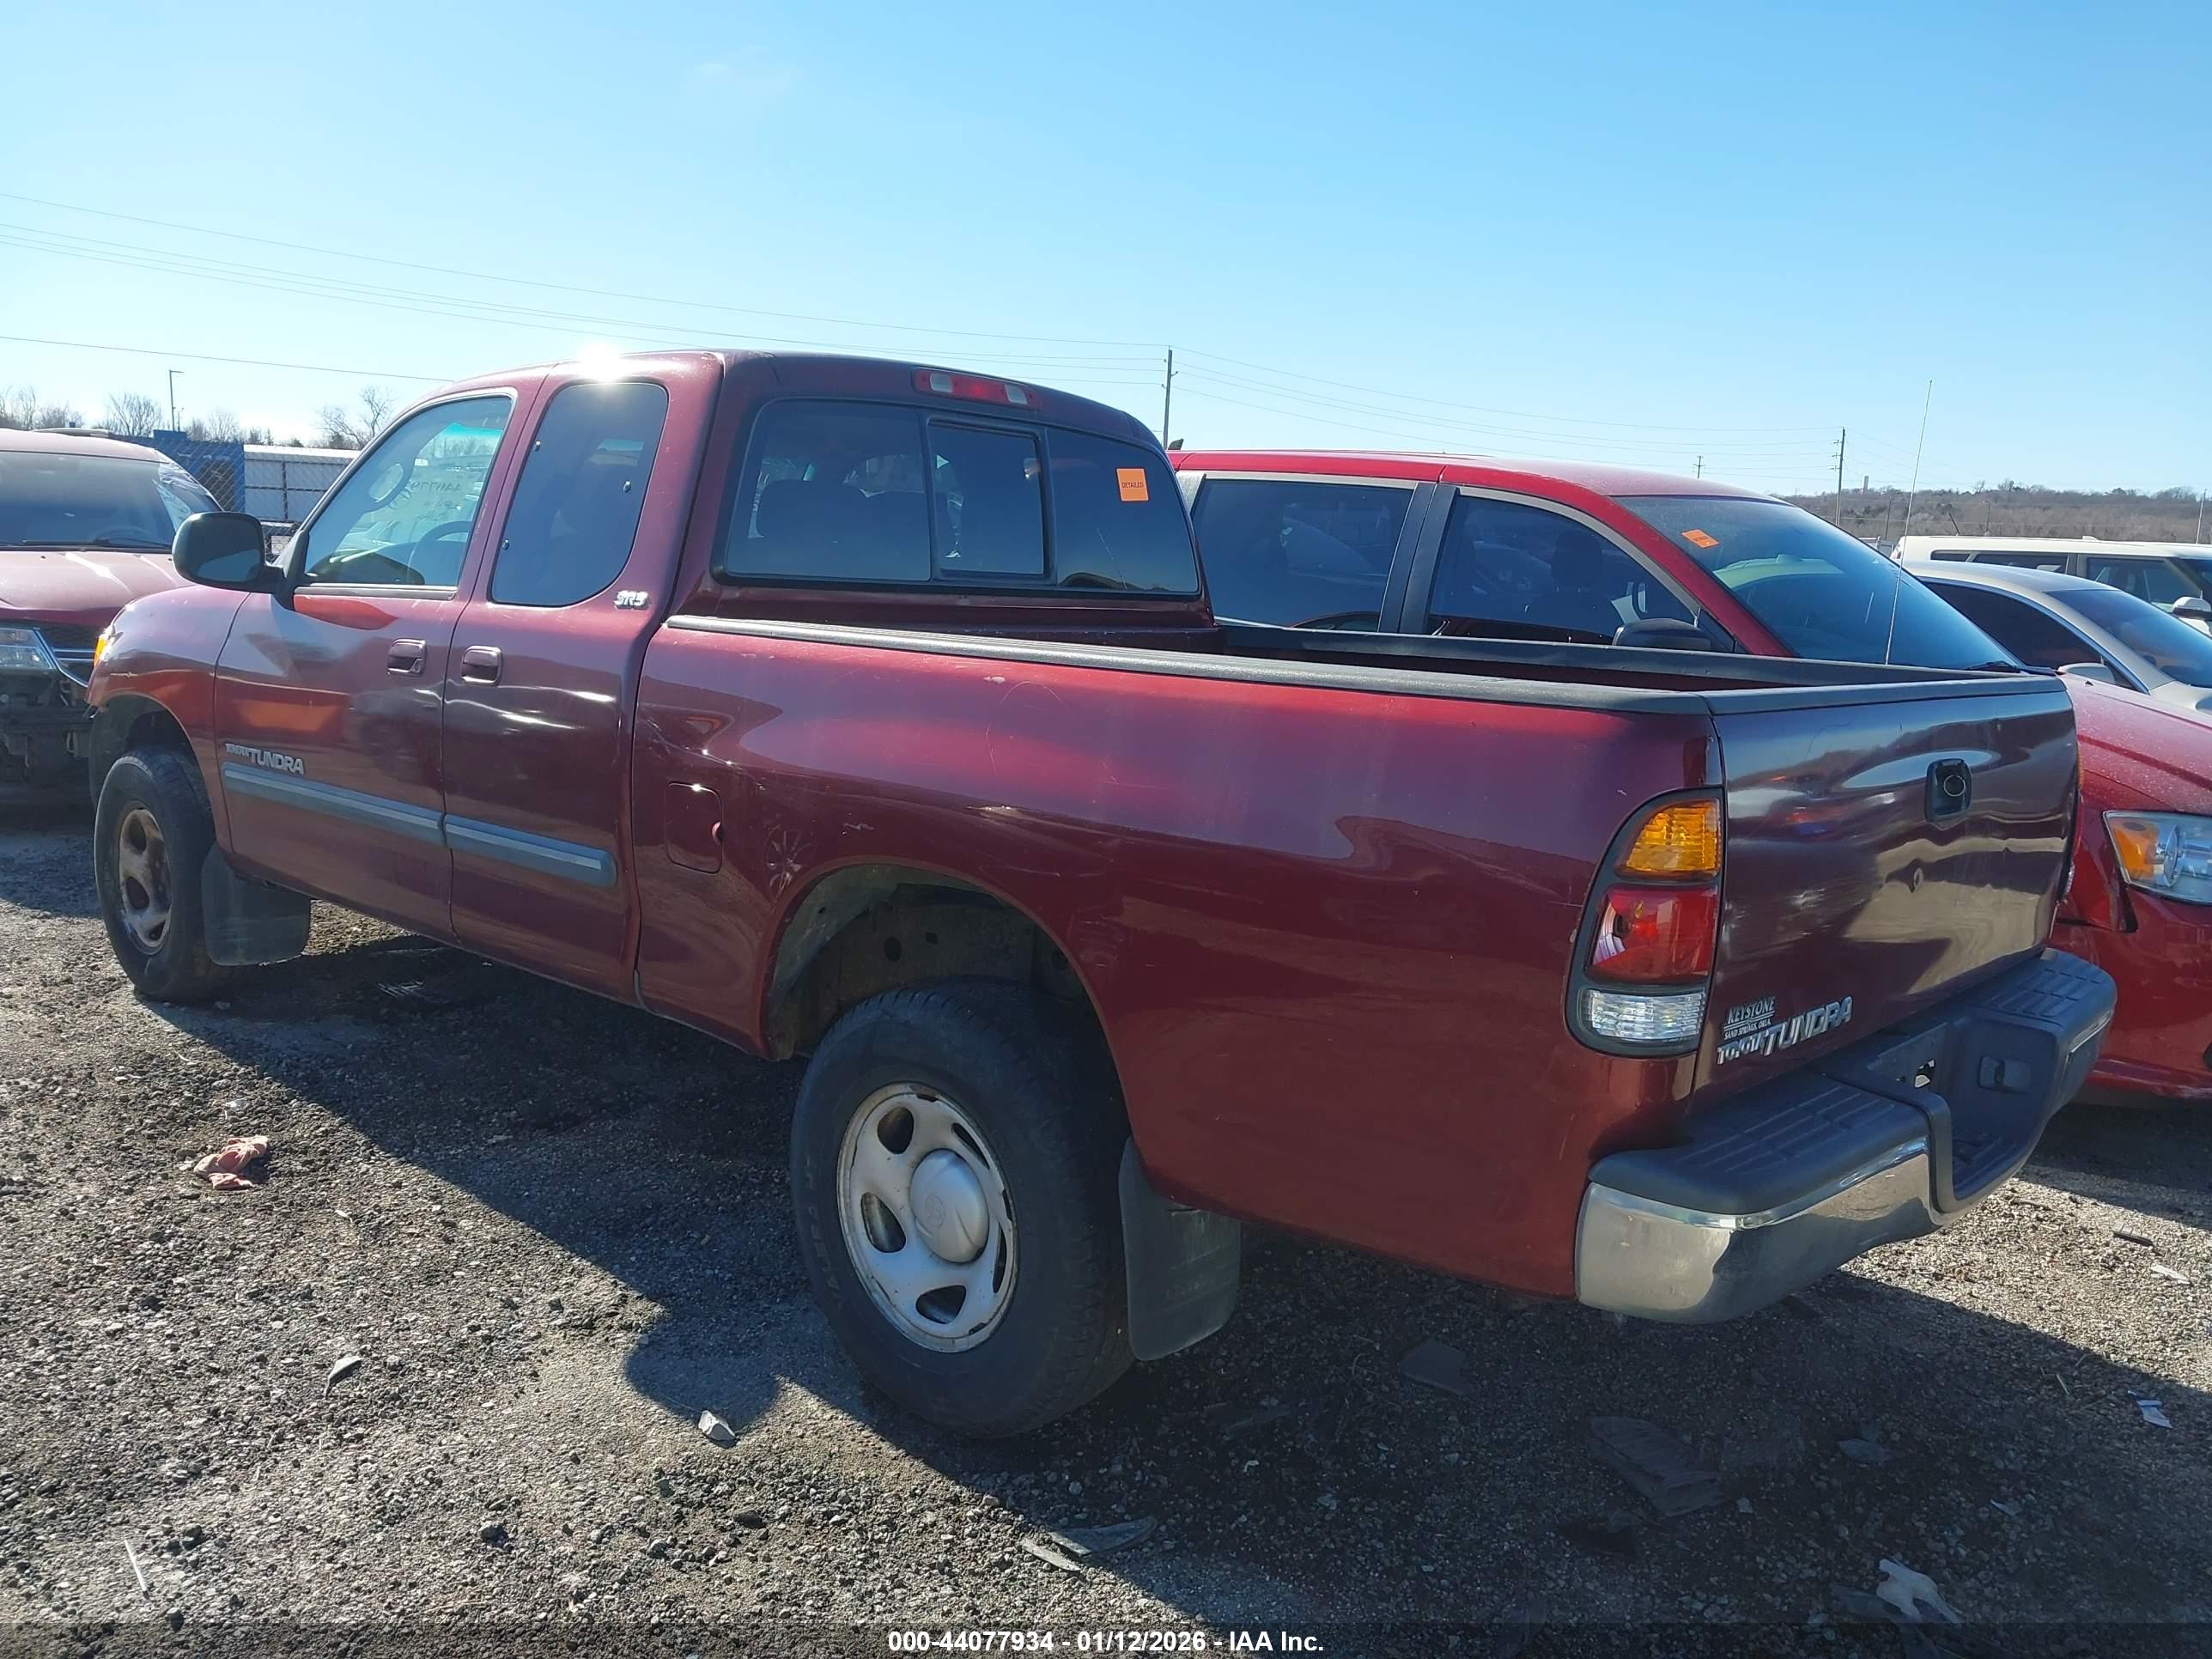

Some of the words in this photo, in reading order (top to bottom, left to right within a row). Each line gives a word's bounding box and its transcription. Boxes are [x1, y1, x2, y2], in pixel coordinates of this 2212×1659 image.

[249, 747, 305, 775] TUNDRA
[1727, 996, 1776, 1024] KEYSTONE
[1723, 1029, 1739, 1041] SAND
[1763, 996, 1853, 1056] TUNDRA
